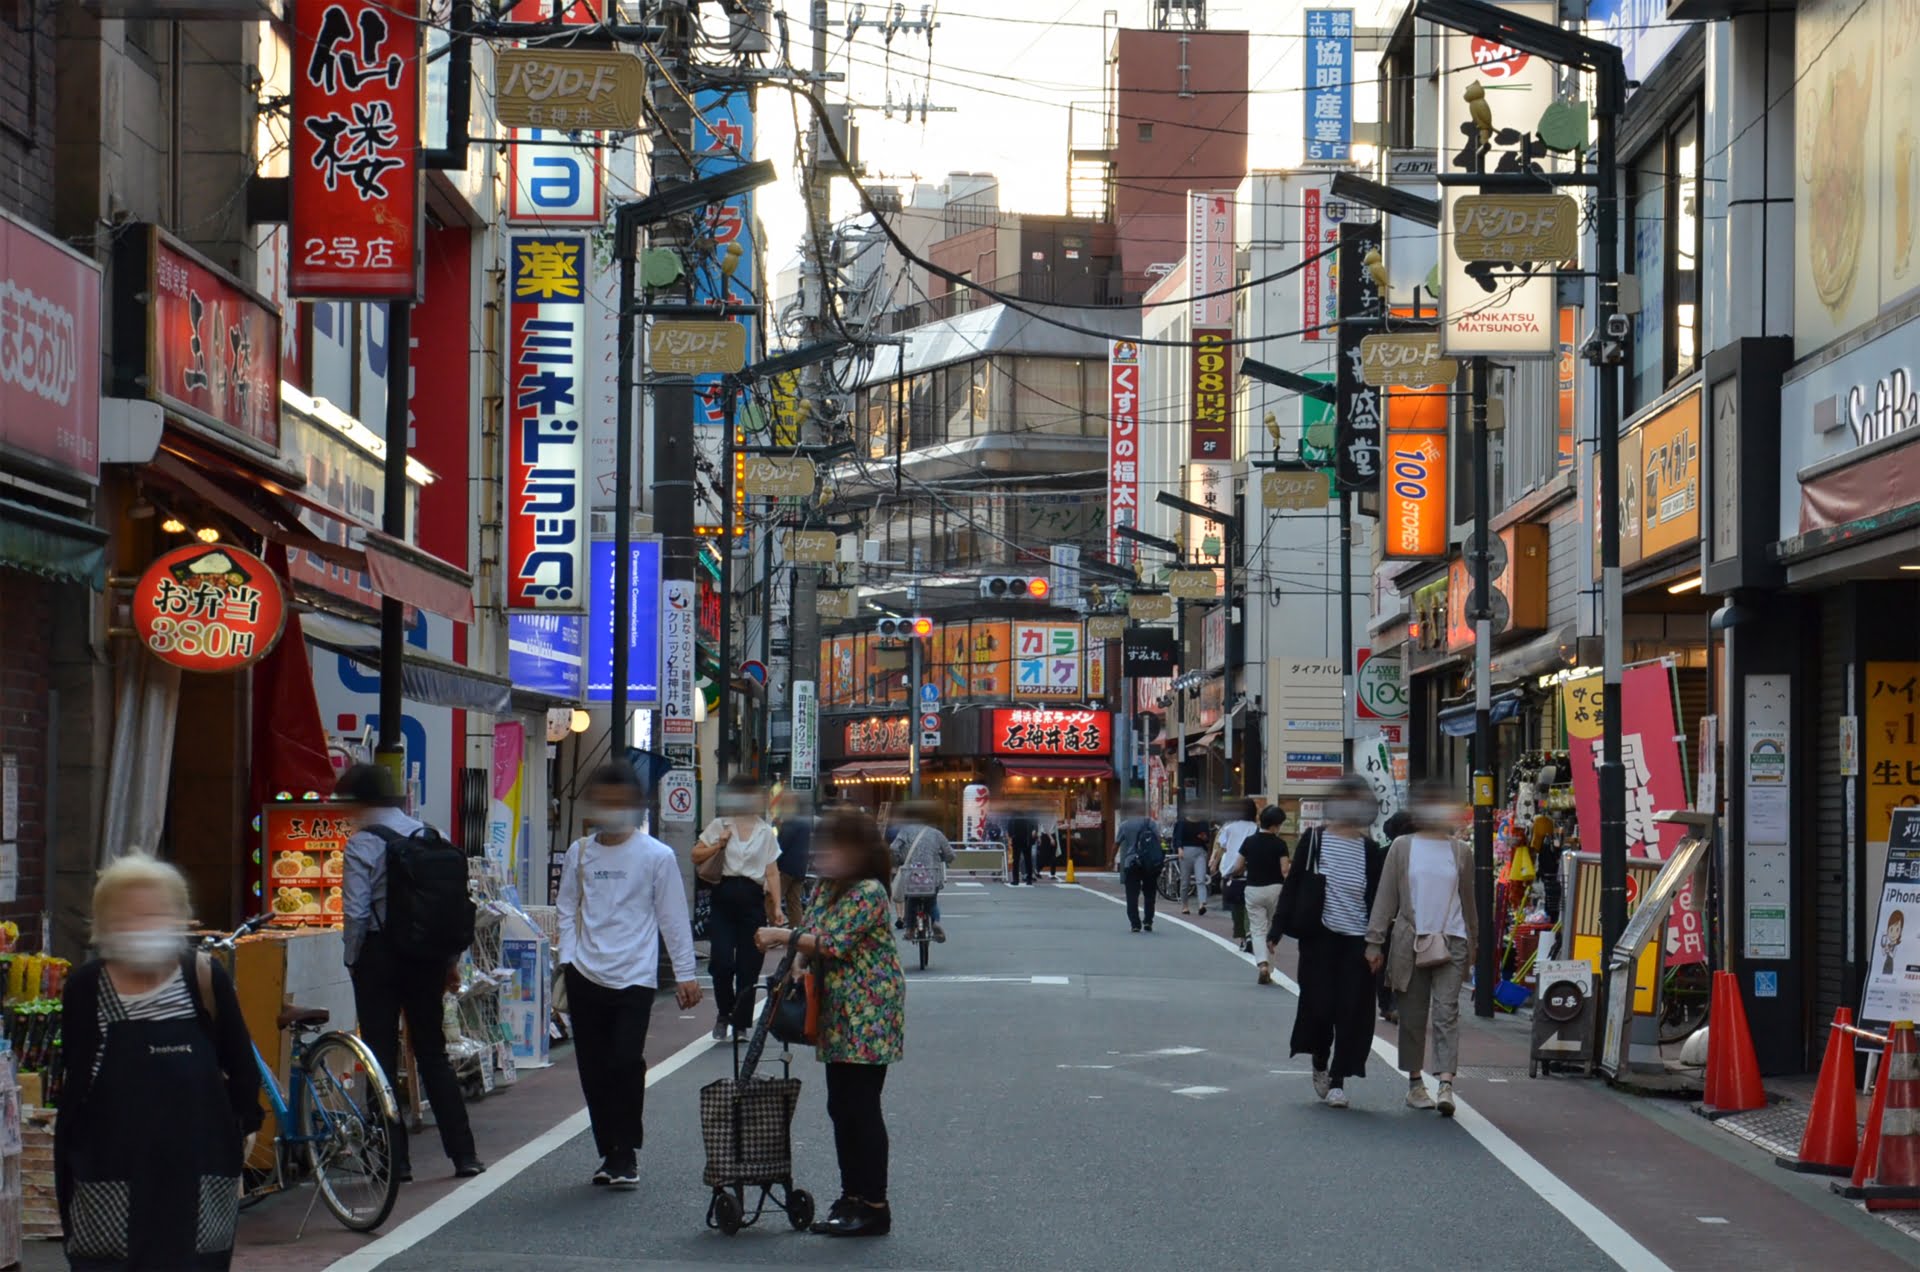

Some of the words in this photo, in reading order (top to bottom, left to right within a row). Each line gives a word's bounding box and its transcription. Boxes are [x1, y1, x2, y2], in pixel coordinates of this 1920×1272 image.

[1314, 40, 1342, 145] 協明産業
[528, 105, 592, 124] 石神井
[304, 237, 394, 269] 2号店
[515, 241, 580, 298] 薬
[518, 319, 579, 603] ミネドラッグ
[1203, 441, 1217, 451] 2F
[1419, 436, 1441, 463] THE
[1395, 450, 1427, 499] 100
[1401, 501, 1419, 552] STORES
[632, 550, 640, 587] Dramatic
[153, 578, 262, 624] お弁当
[631, 588, 639, 647] Communication
[149, 616, 255, 658] 380円
[1022, 629, 1075, 654] カラ
[1127, 650, 1162, 661] すみれ
[1020, 659, 1075, 684] オケ
[1003, 723, 1101, 753] 石神井商店
